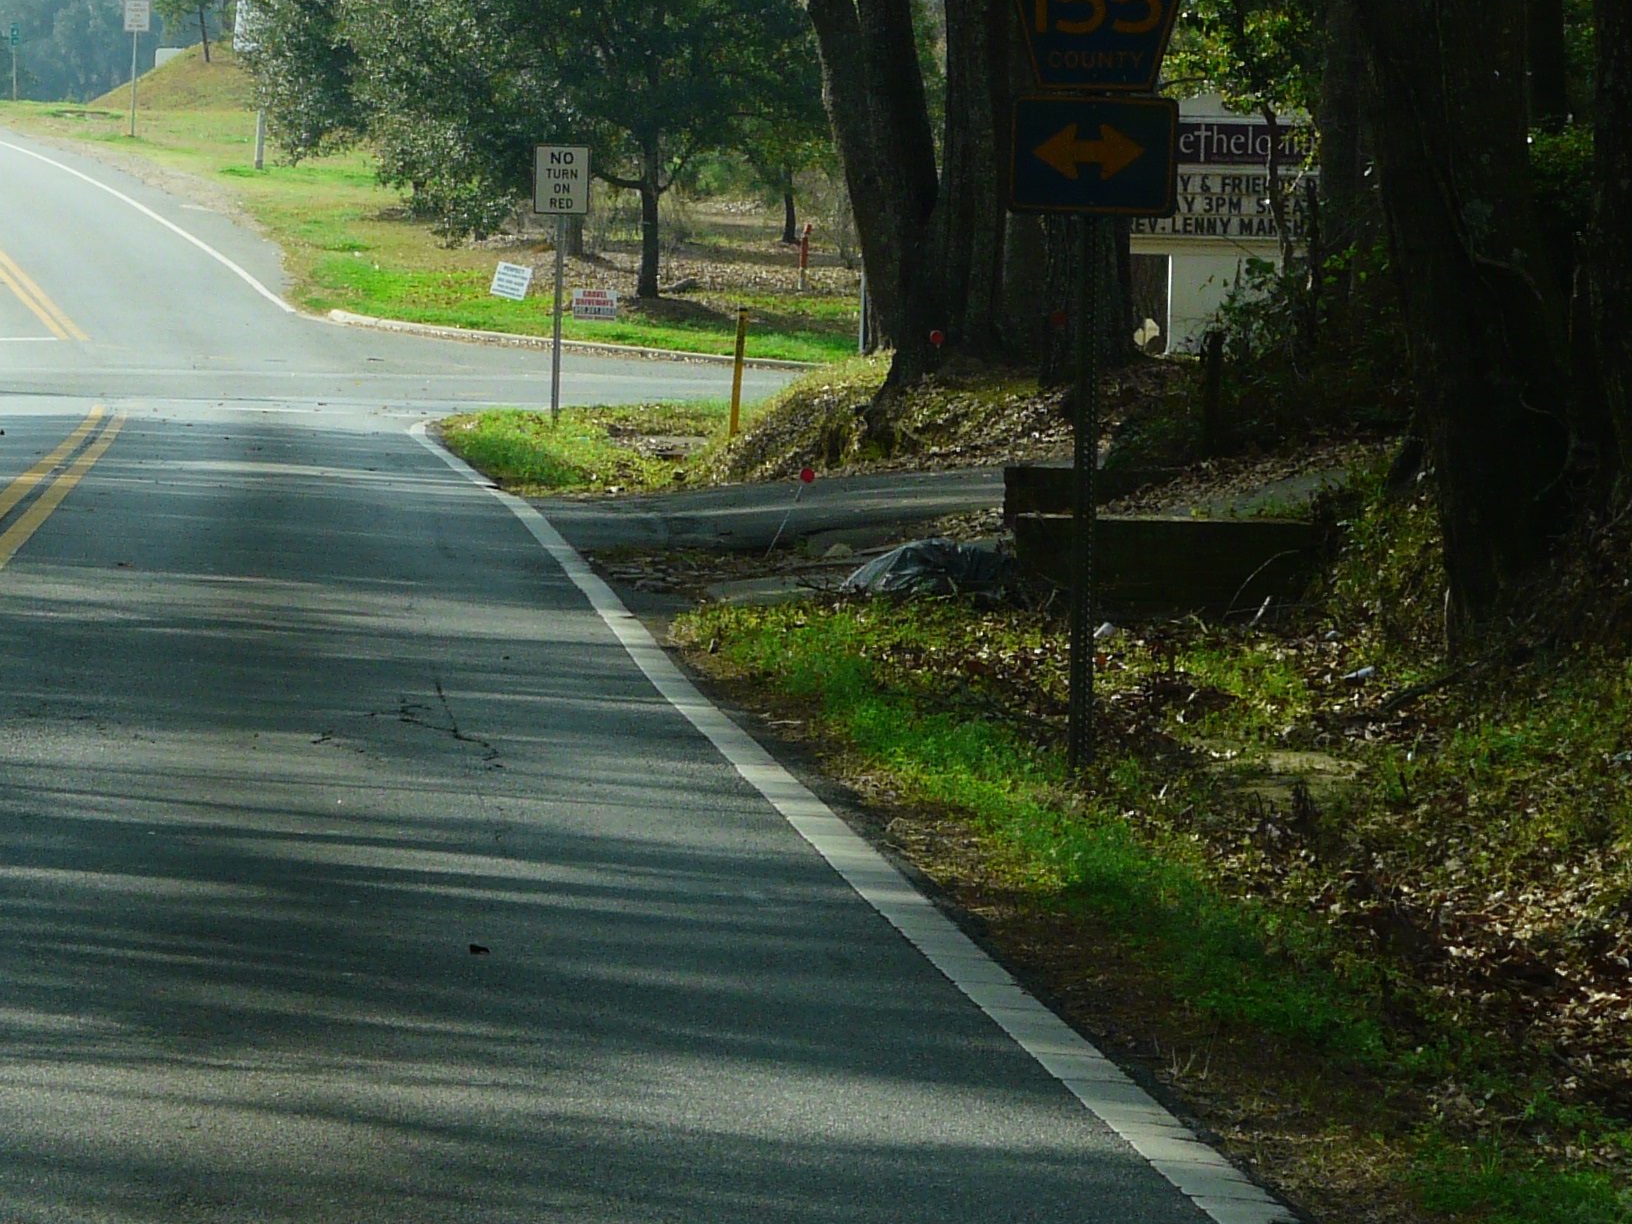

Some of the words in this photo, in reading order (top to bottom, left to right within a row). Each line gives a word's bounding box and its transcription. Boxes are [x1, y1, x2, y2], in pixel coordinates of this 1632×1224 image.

[1048, 50, 1145, 69] COUNTY
[550, 150, 574, 165] NO
[545, 168, 578, 180] TURN
[553, 183, 570, 194] ON
[549, 197, 573, 210] RED
[1203, 197, 1241, 214] 3PM
[1172, 217, 1231, 234] LENNY
